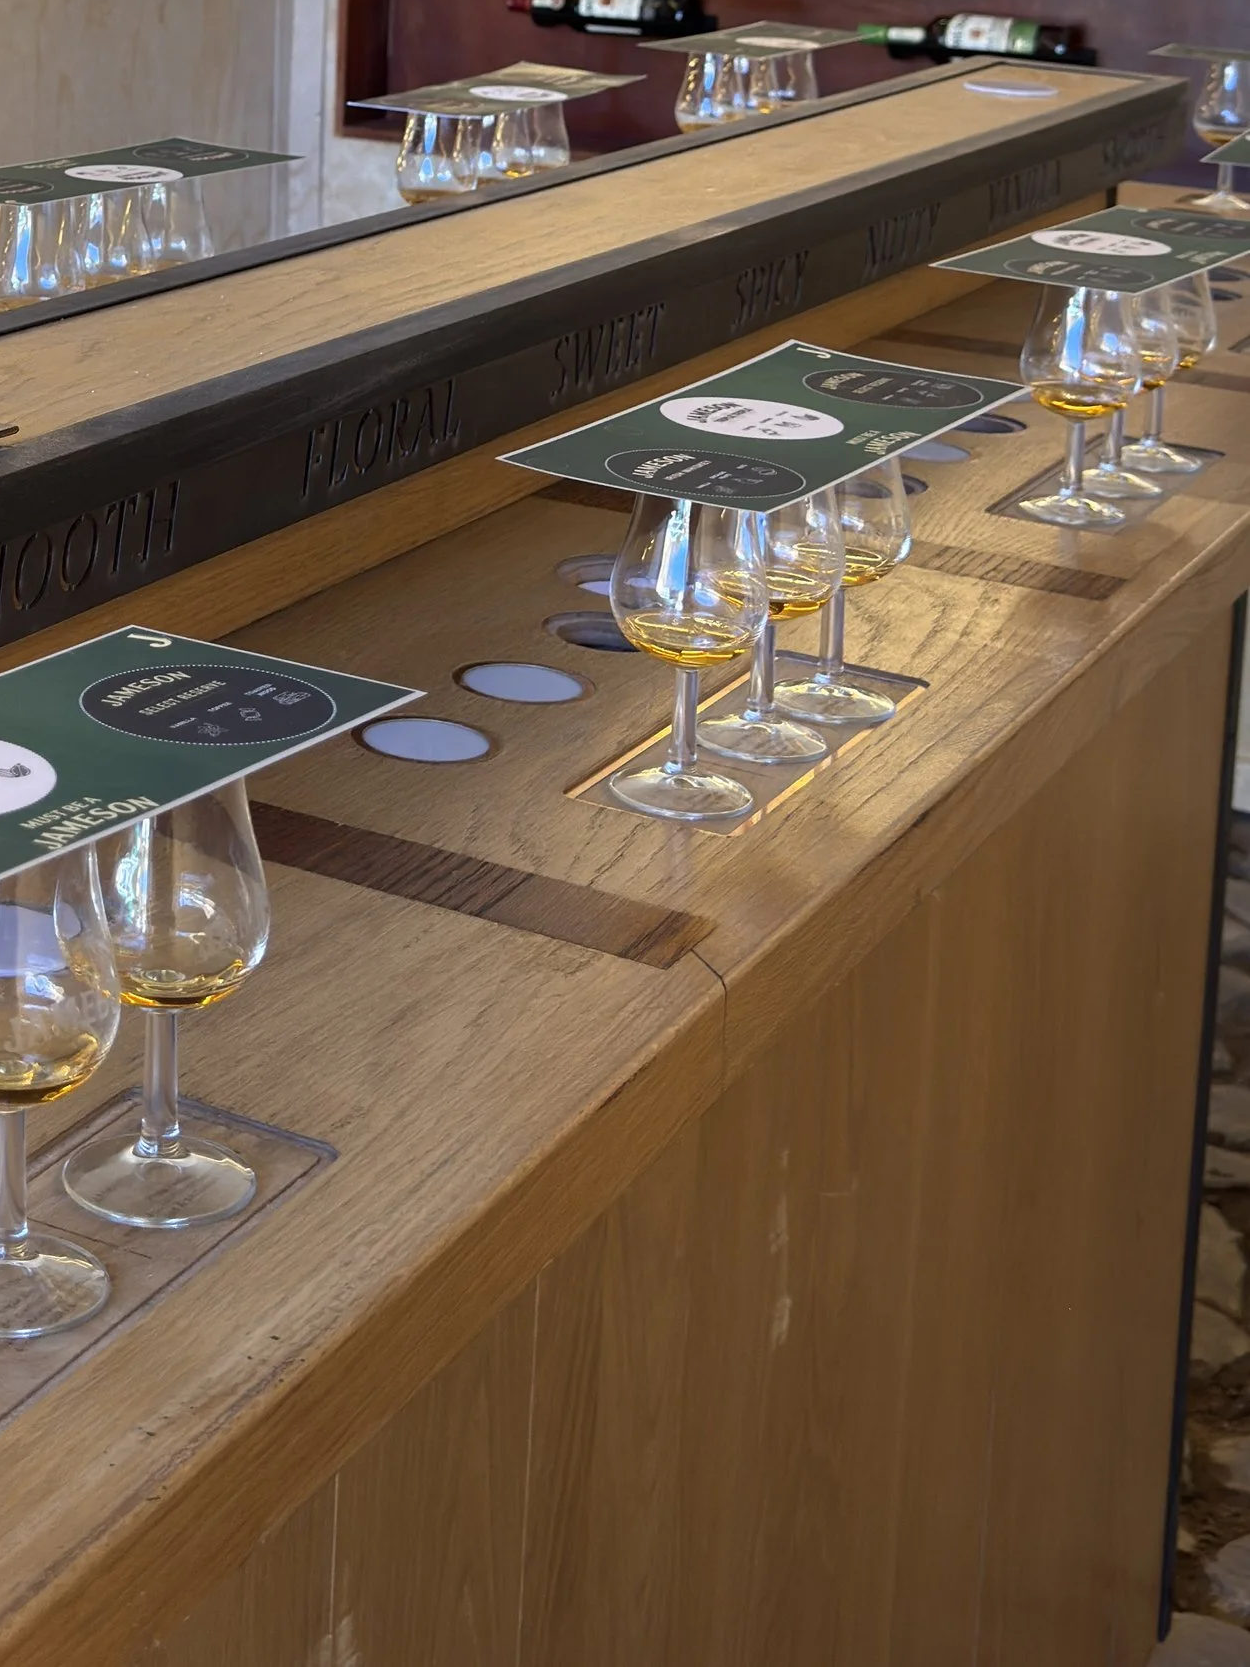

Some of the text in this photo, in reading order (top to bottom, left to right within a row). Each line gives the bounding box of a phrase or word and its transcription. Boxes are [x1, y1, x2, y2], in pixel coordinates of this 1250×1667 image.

[549, 301, 667, 398] SWEET
[300, 372, 463, 500] FLORAL
[632, 453, 697, 480] JAMESON
[127, 632, 172, 648] J
[100, 669, 192, 708] JAMESON
[138, 679, 227, 717] SELECT RESERVE
[18, 796, 103, 830] MUST BE A
[32, 795, 161, 850] JAMESON
